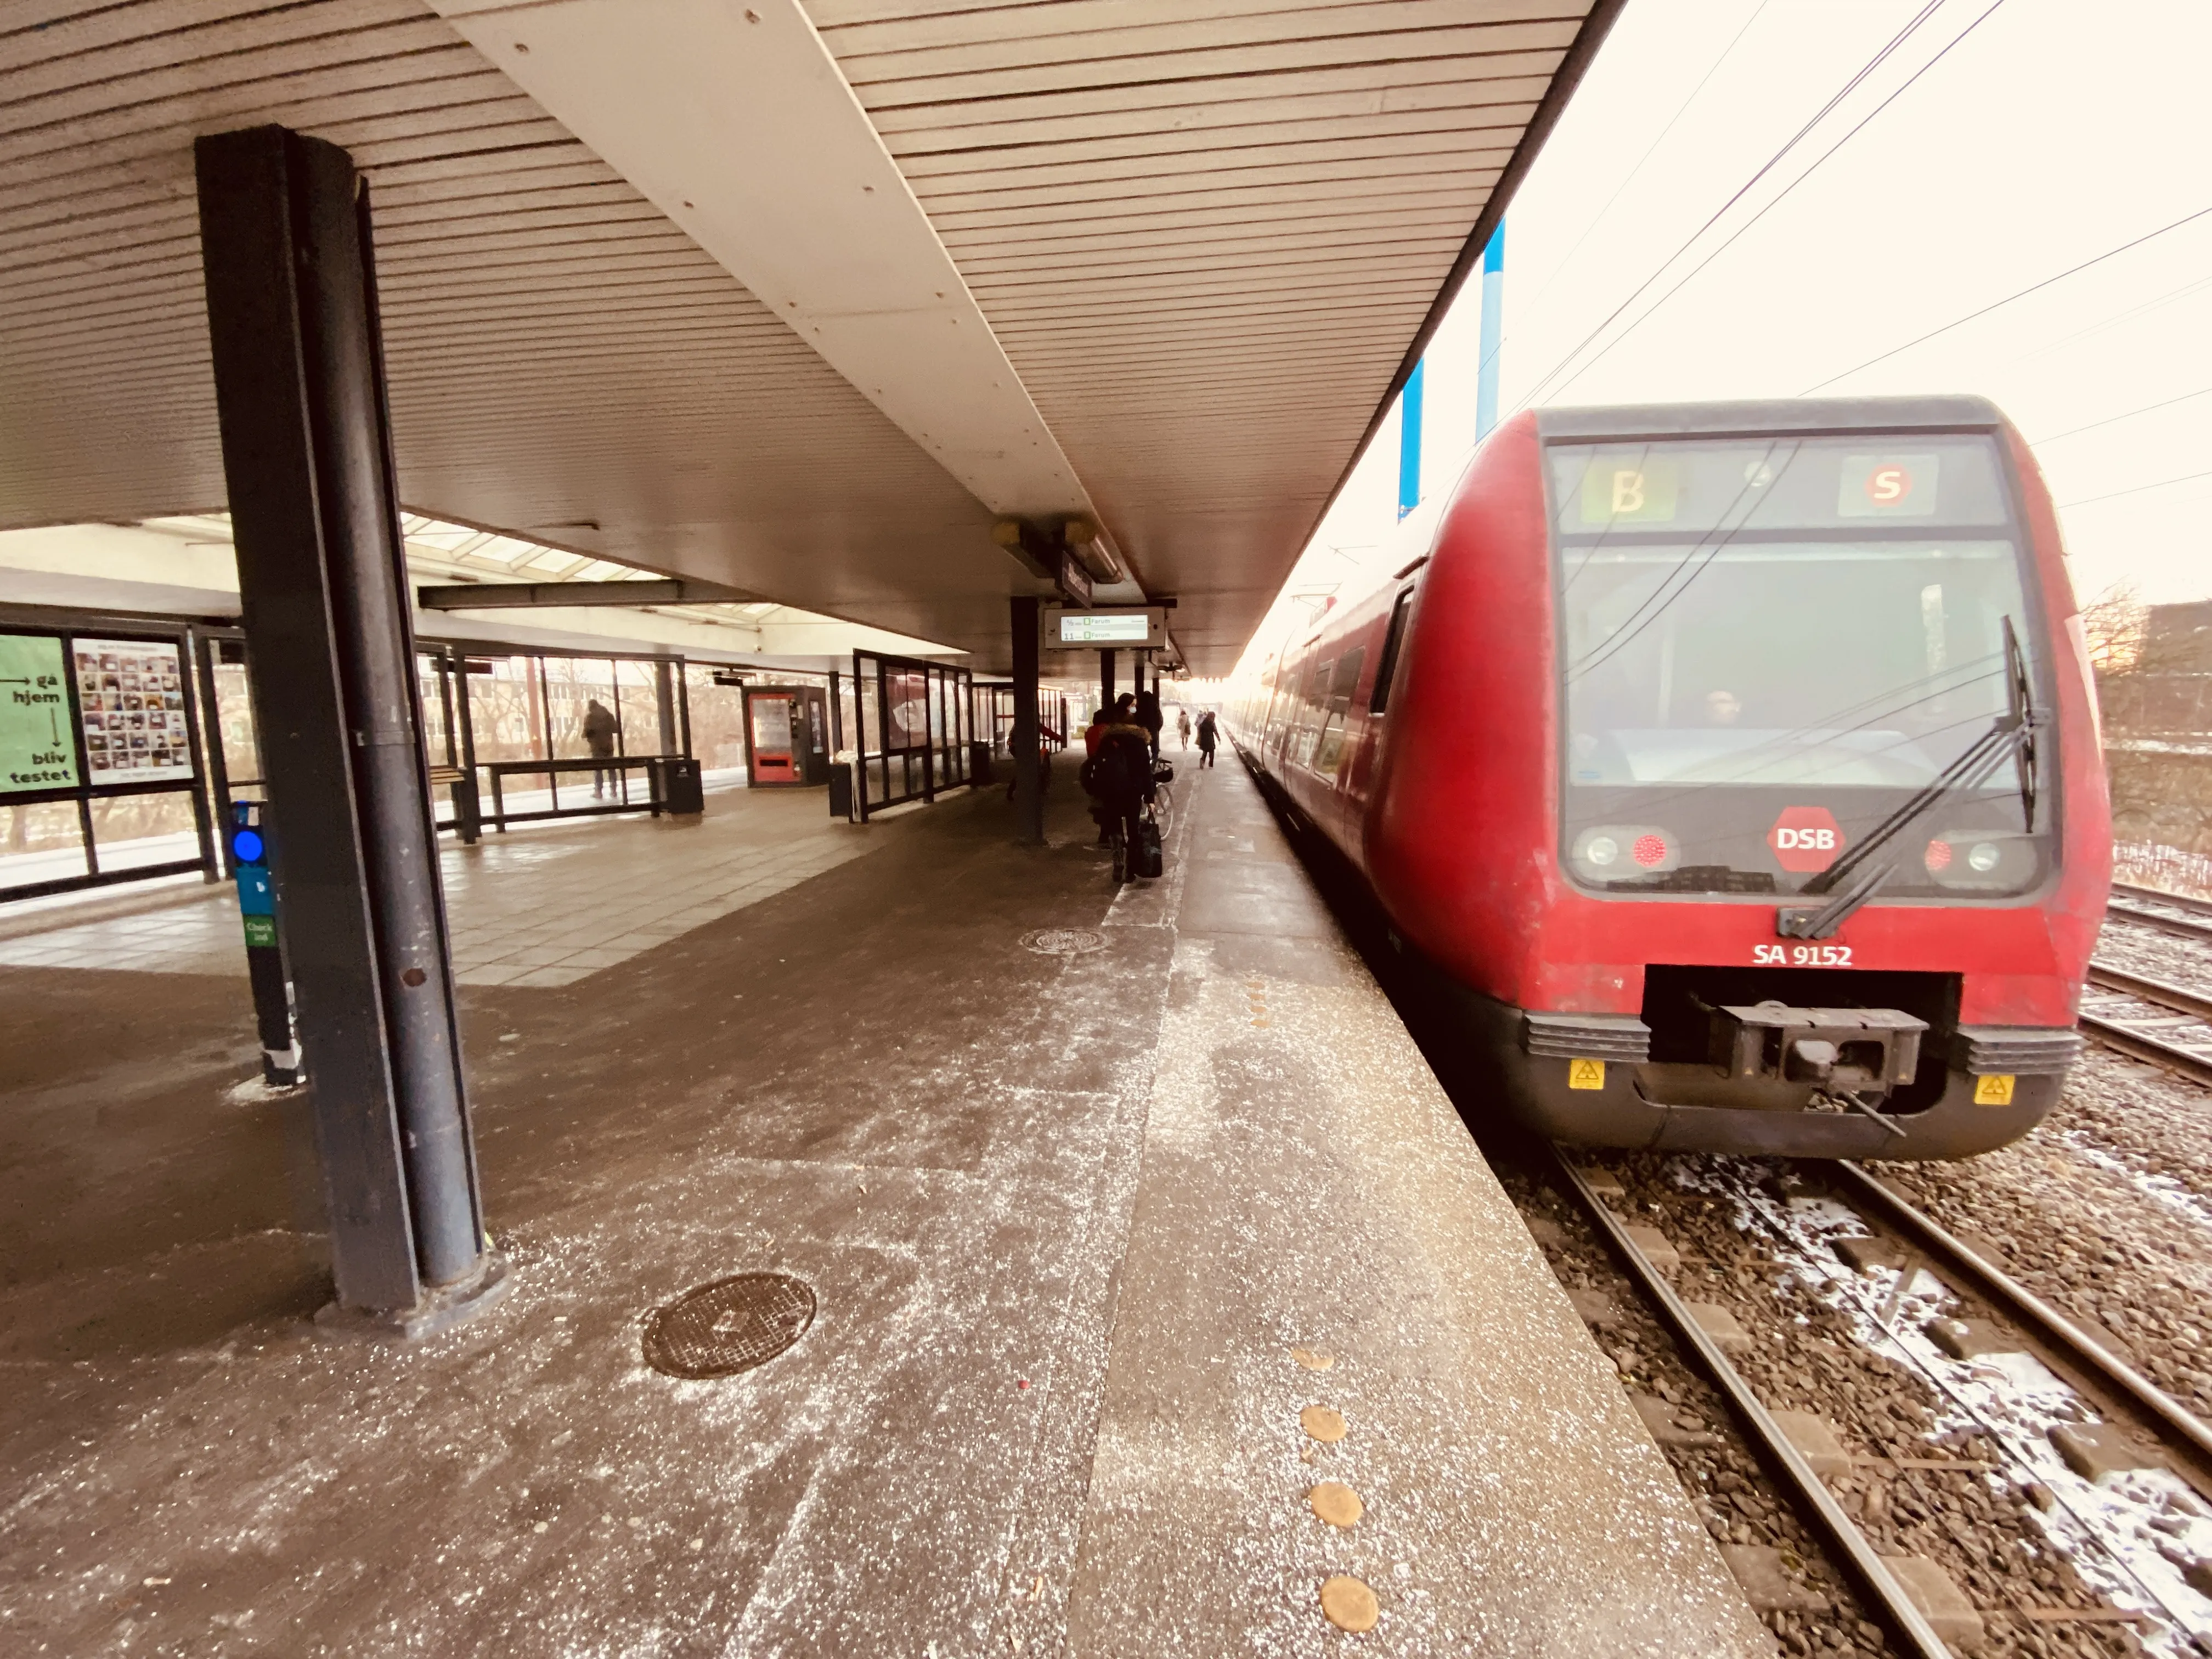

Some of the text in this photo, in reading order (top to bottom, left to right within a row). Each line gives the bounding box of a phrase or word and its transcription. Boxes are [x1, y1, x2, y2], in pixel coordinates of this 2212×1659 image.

[1612, 470, 1645, 512] B
[1874, 471, 1901, 499] S
[36, 674, 58, 689] gå
[13, 690, 60, 706] hjem
[32, 751, 67, 765] bliv
[10, 770, 71, 783] testet
[1777, 828, 1835, 849] DSB
[1753, 944, 1853, 966] SA 9152
